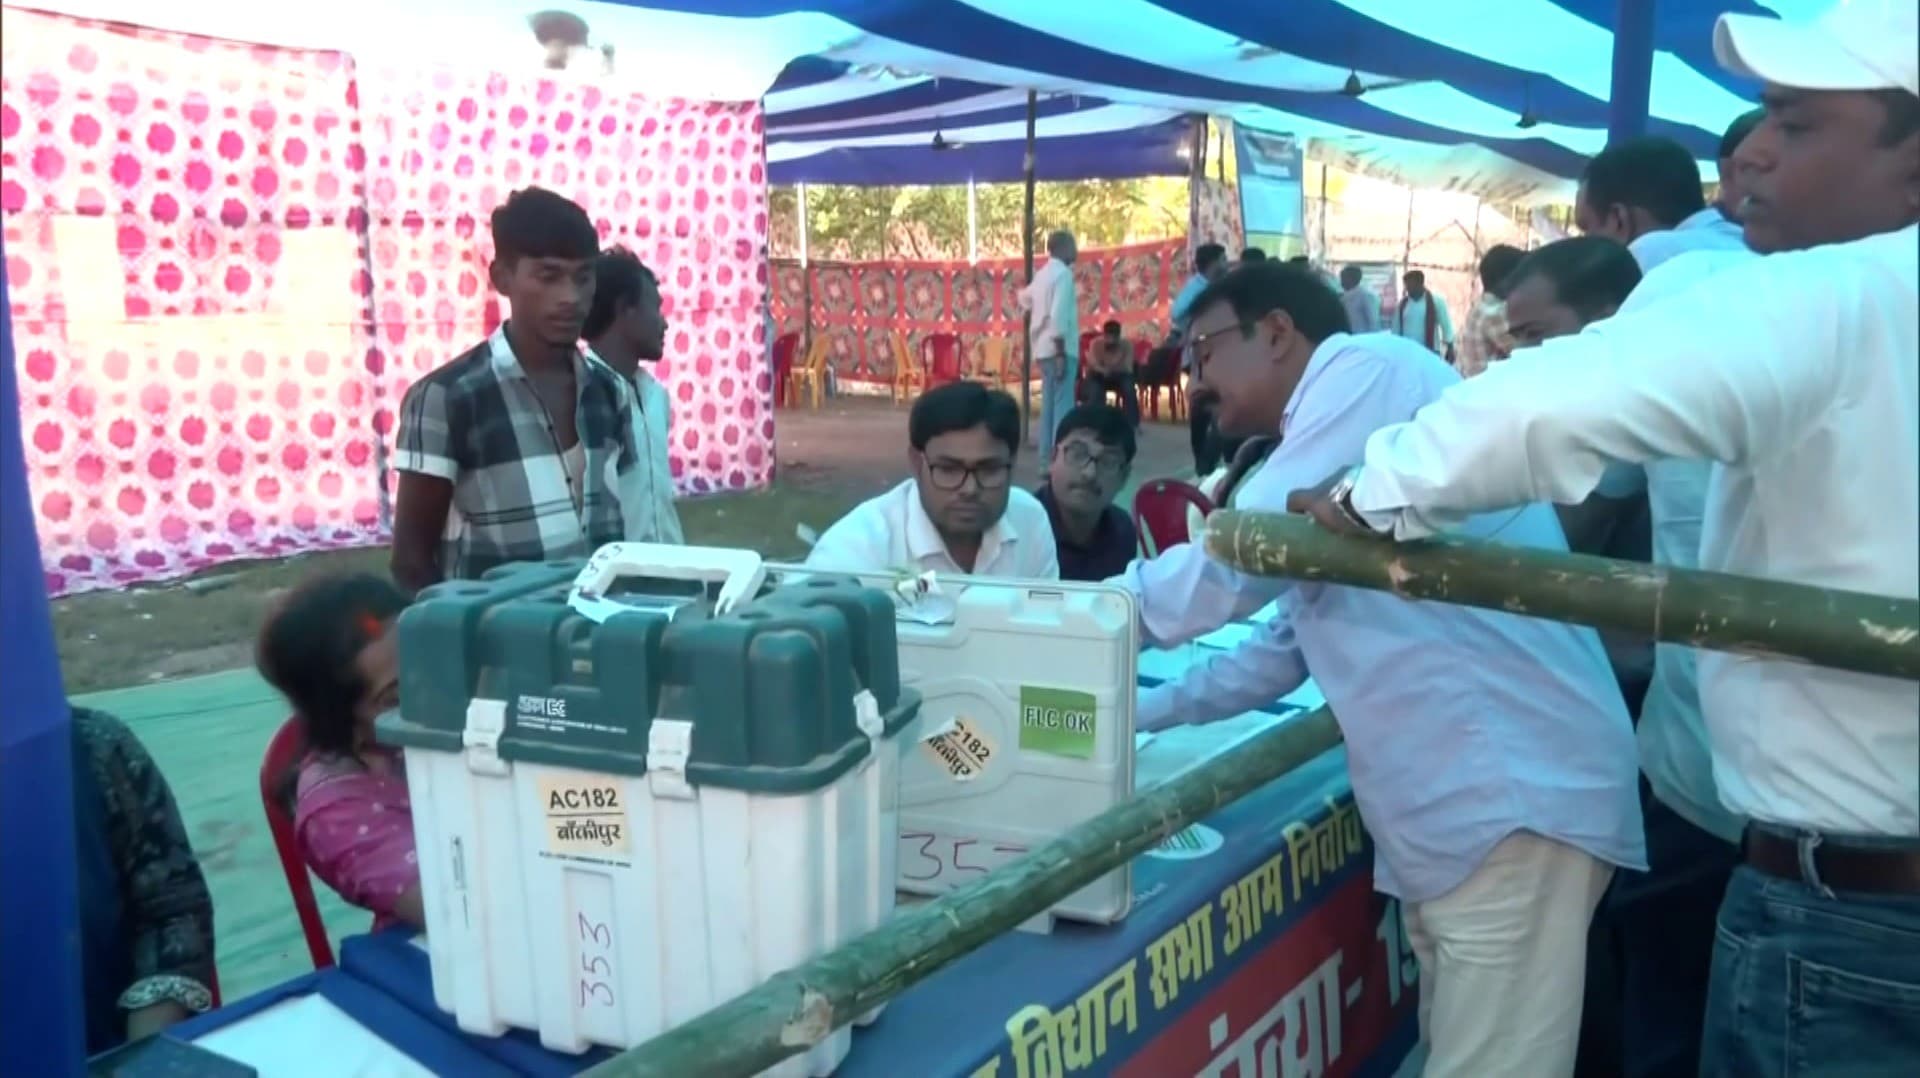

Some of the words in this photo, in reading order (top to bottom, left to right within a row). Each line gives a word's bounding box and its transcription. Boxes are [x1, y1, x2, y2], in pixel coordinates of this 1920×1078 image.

[950, 719, 990, 763] C182
[1024, 705, 1059, 728] FLC
[1065, 710, 1092, 732] OK
[550, 787, 618, 809] AC182
[900, 832, 1030, 889] 35
[577, 912, 616, 1008] 353
[1006, 957, 1138, 1078] विधान
[1146, 902, 1214, 1010] सभा
[1220, 852, 1284, 956] आम
